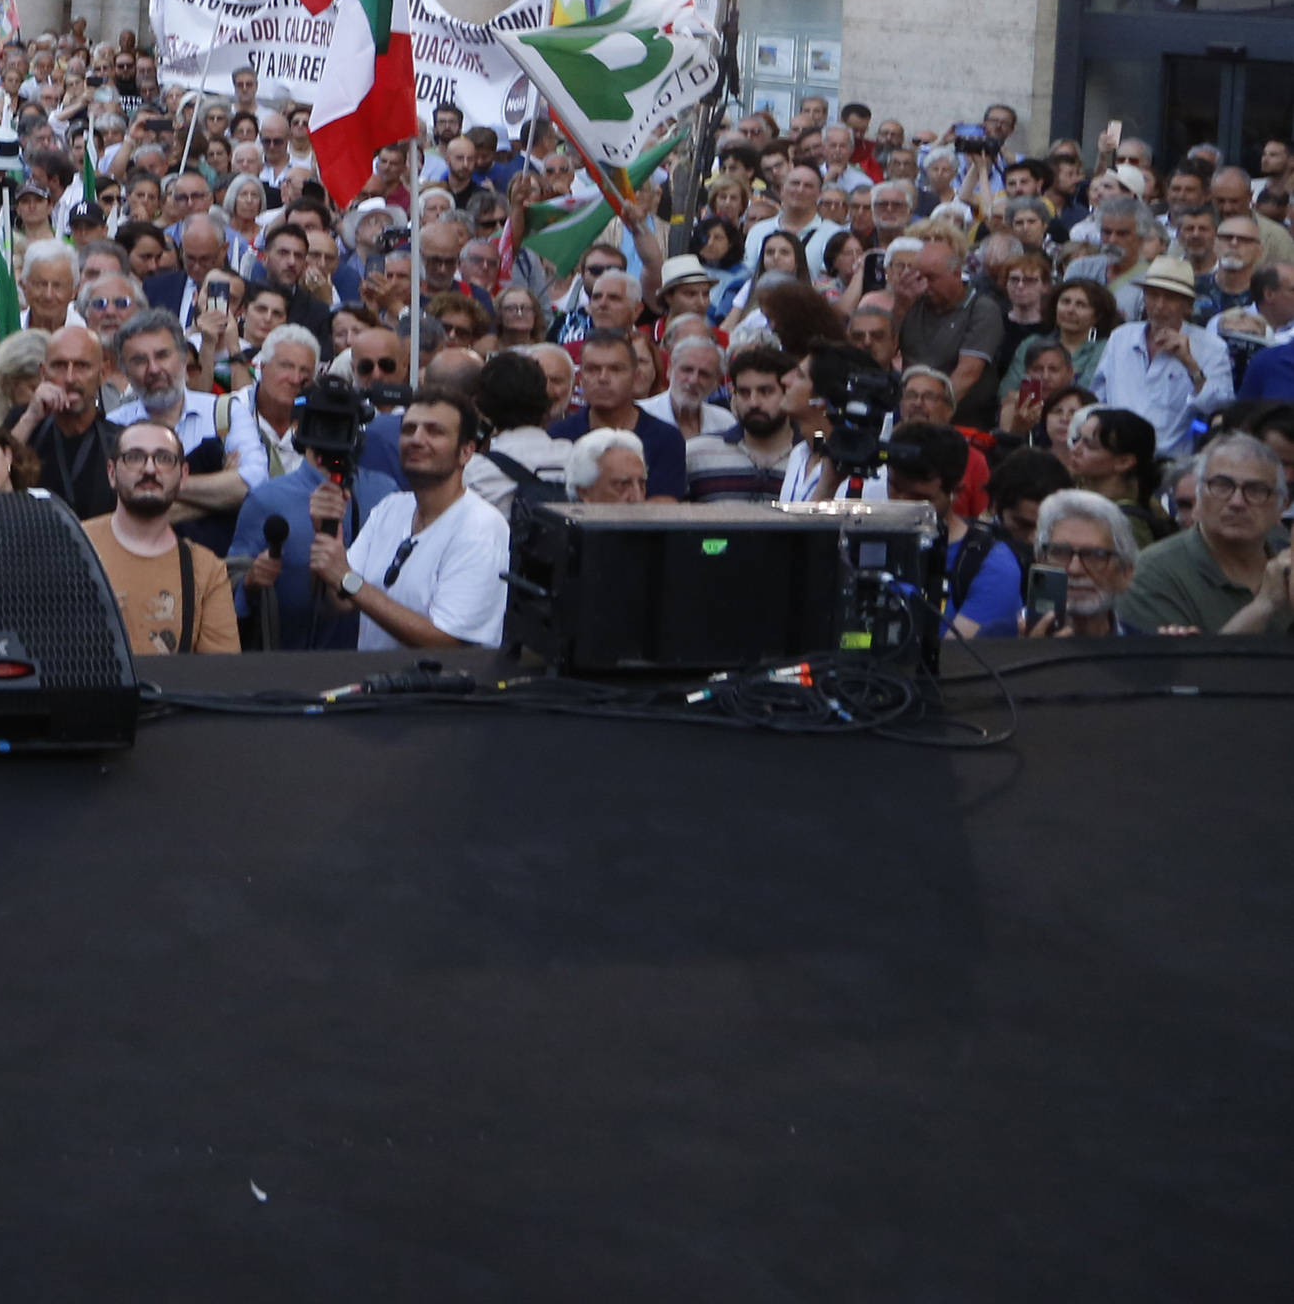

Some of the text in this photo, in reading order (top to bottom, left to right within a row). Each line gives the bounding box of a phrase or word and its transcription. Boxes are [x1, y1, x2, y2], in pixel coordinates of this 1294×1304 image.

[251, 17, 280, 42] DDL
[284, 17, 334, 48] CALDERO
[266, 52, 276, 76] A
